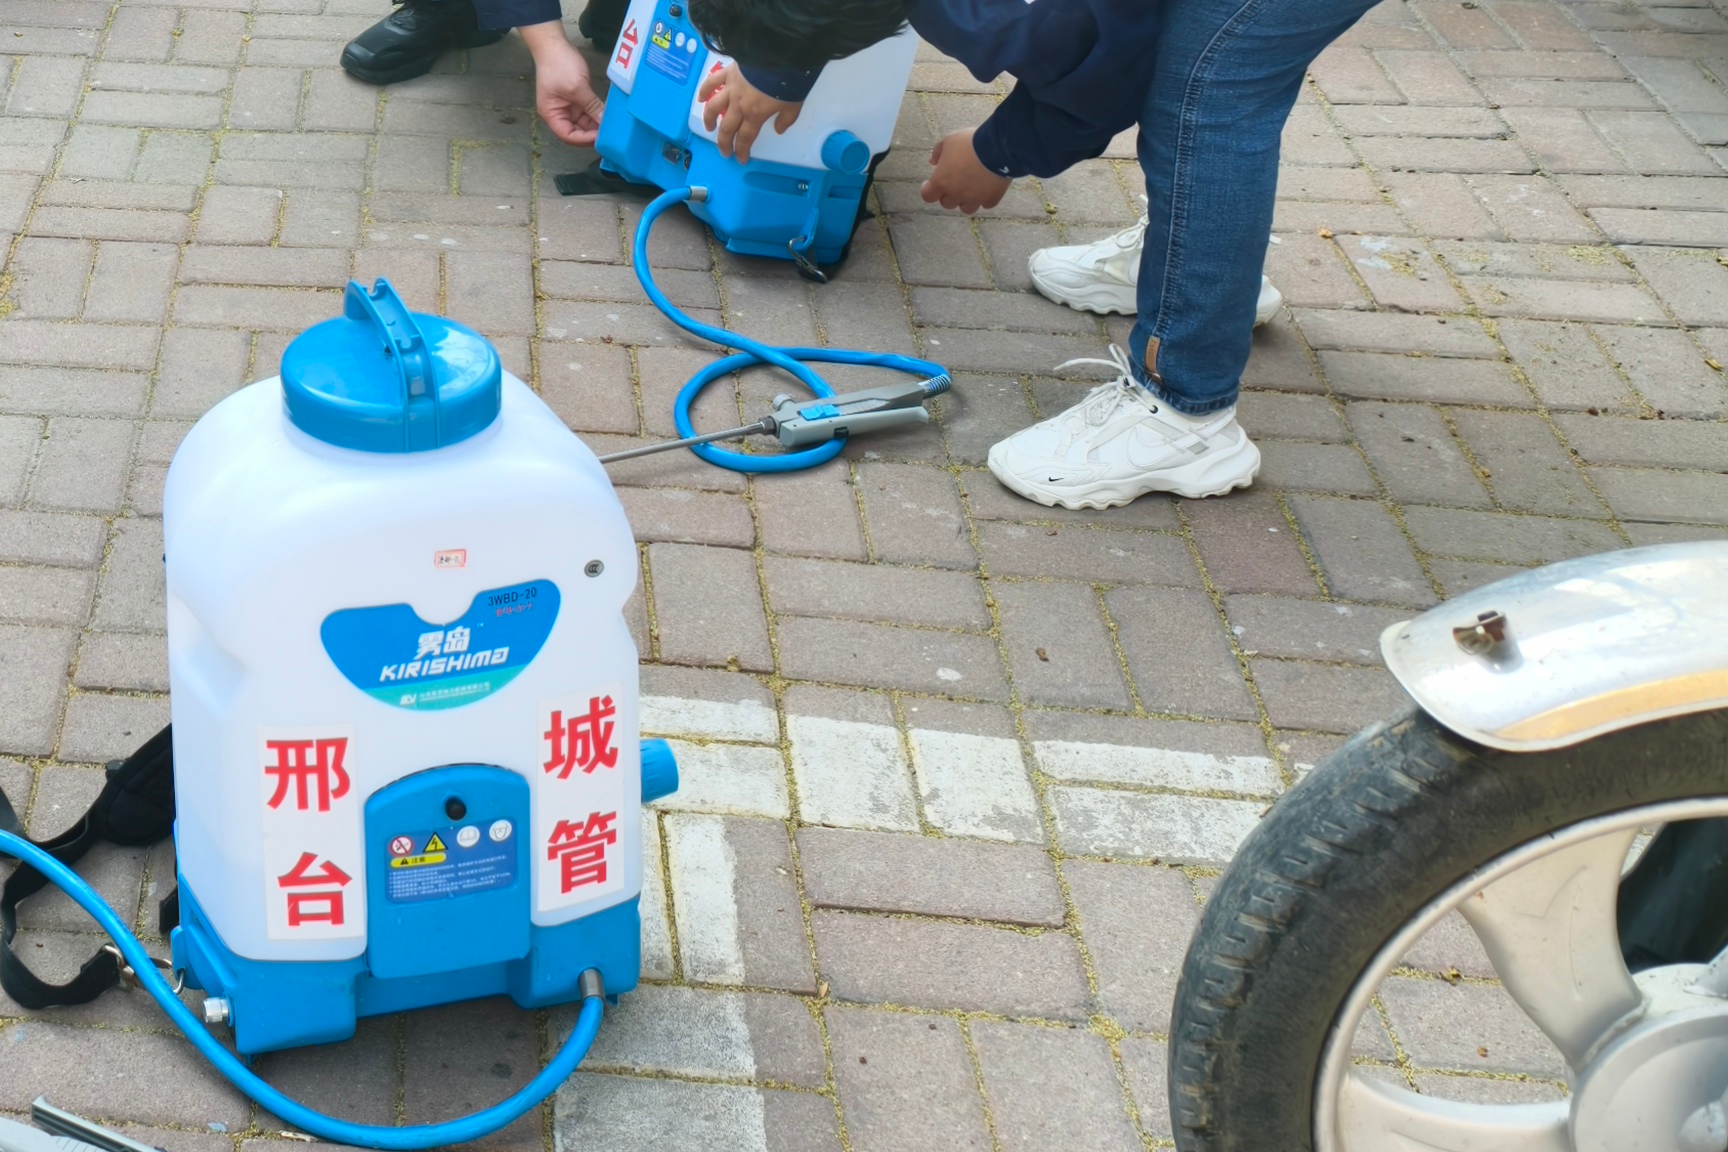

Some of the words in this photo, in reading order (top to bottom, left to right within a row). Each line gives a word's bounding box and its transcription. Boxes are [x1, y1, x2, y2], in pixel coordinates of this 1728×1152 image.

[413, 625, 471, 661] 雾岛
[488, 587, 538, 607] 3WBD-20
[264, 736, 353, 927] 邢台
[542, 695, 619, 894] 城管
